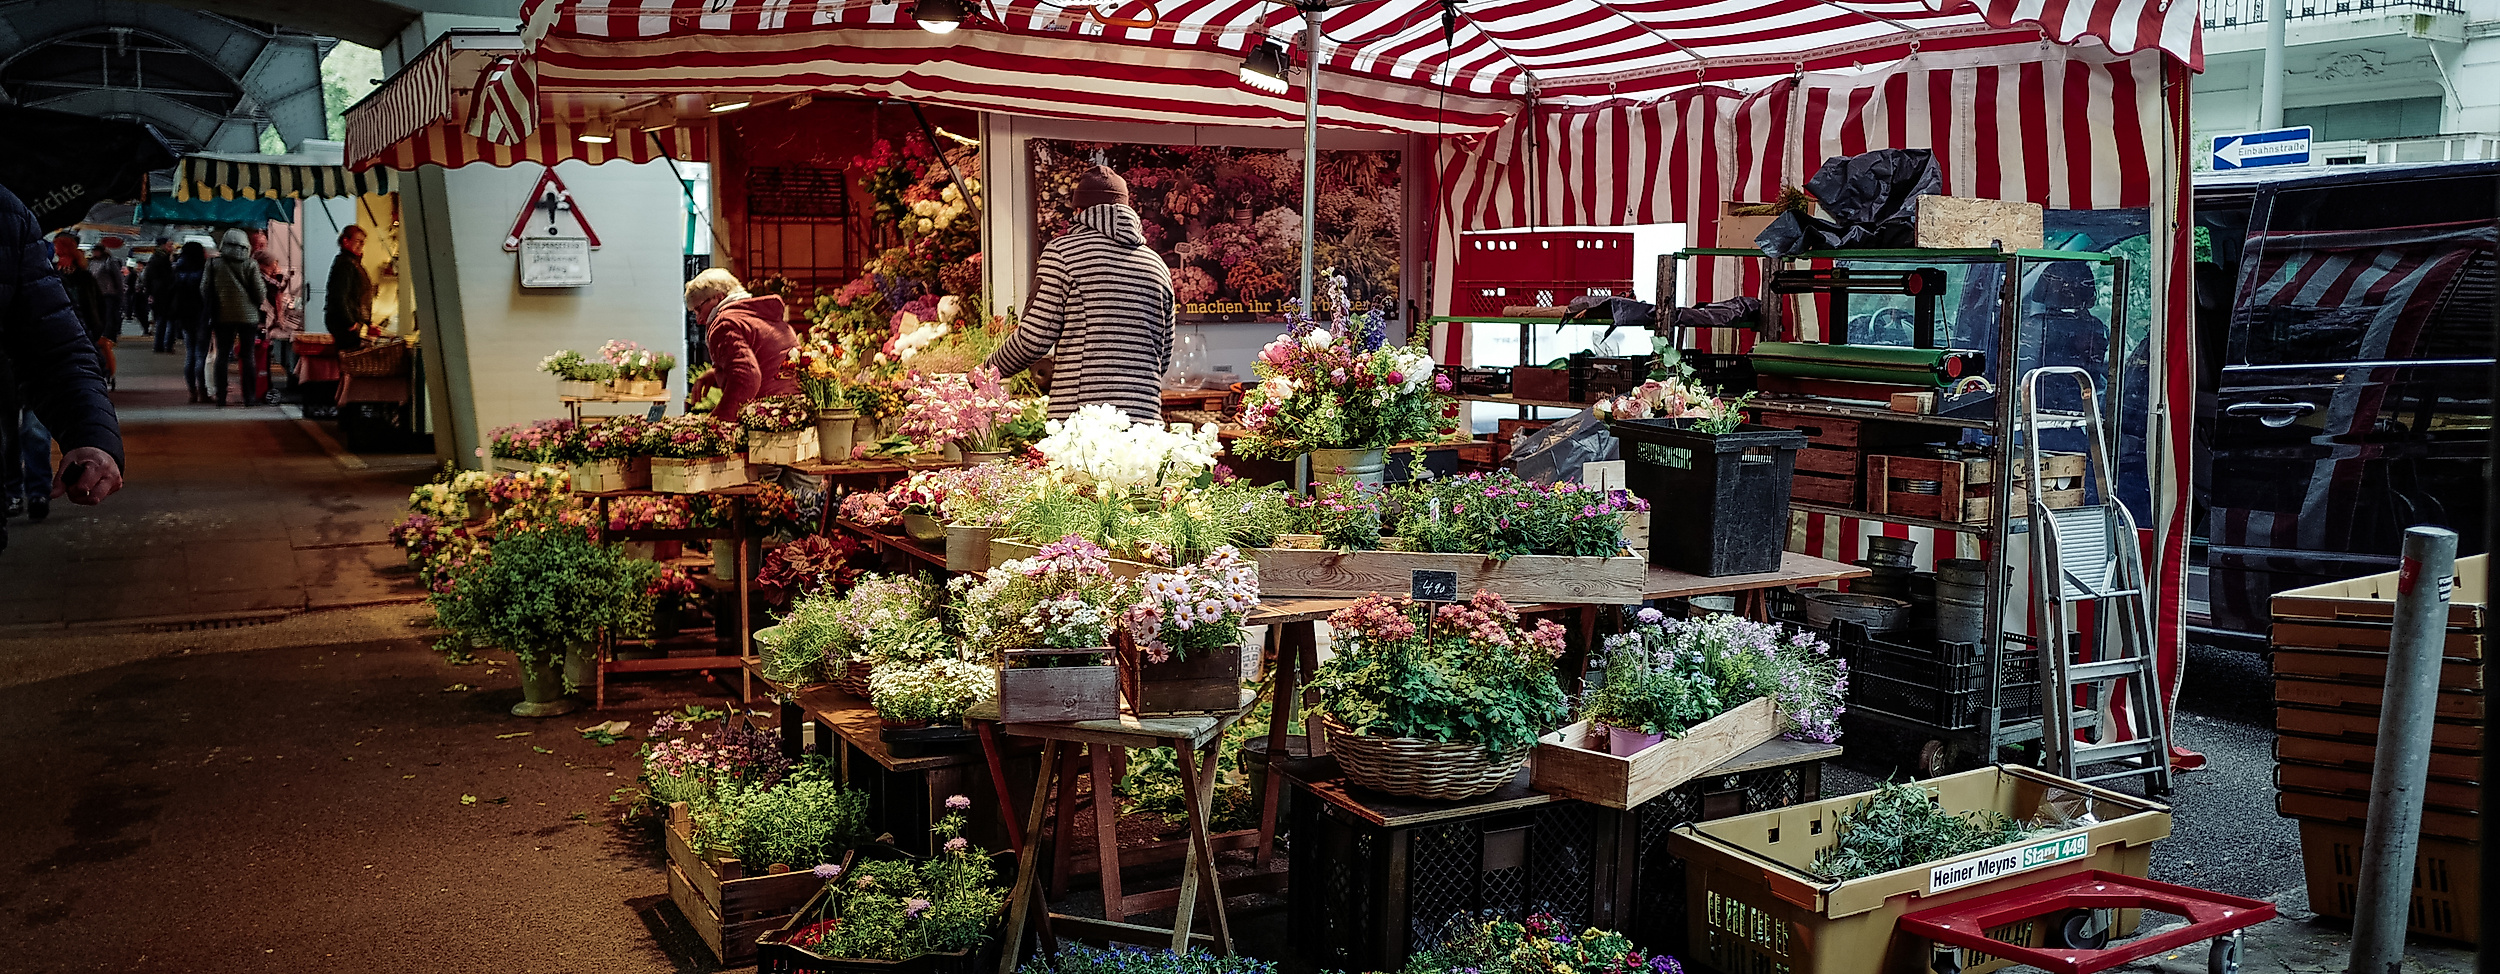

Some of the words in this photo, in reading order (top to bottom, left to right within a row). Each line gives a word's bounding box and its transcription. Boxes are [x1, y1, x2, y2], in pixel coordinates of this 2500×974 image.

[2238, 142, 2305, 156] Einbahnstraße
[31, 184, 85, 217] richte
[1185, 300, 1244, 314] machen
[1247, 299, 1272, 313] ihr
[1933, 866, 1975, 888] Heiner
[1977, 856, 2017, 877] Meyns
[2061, 837, 2085, 857] 449
